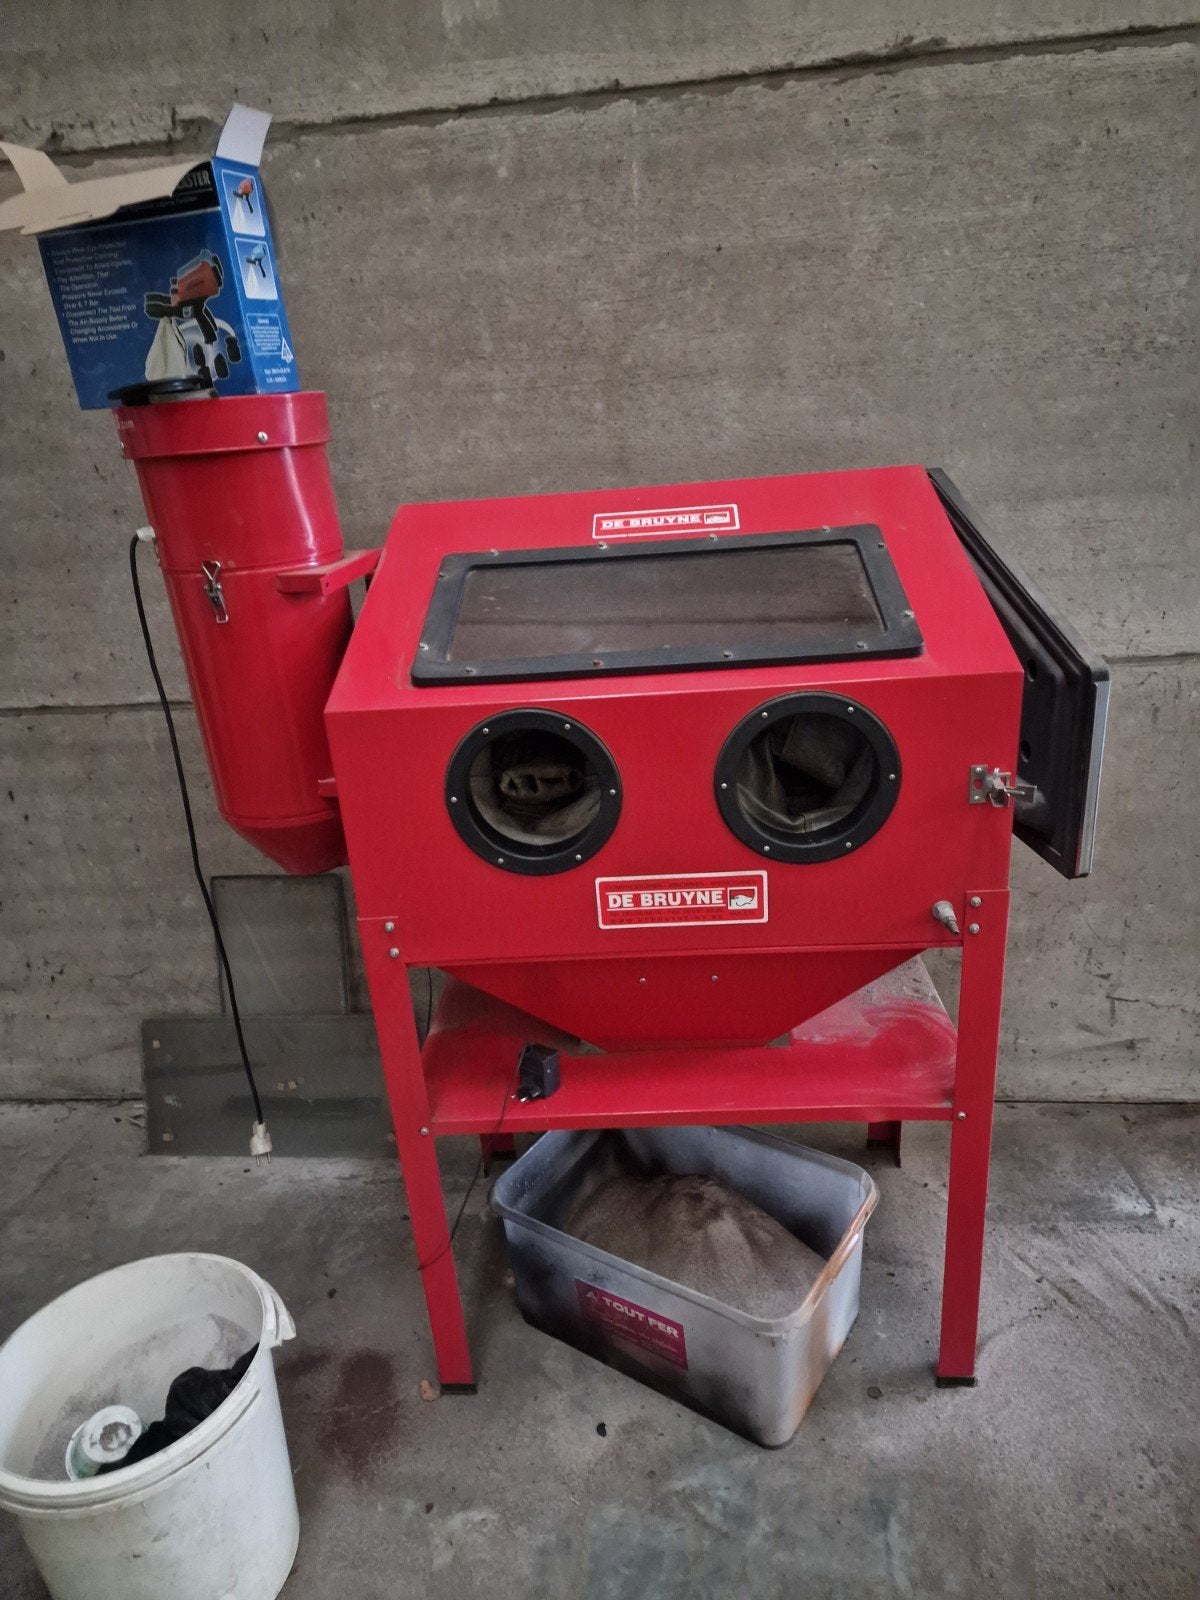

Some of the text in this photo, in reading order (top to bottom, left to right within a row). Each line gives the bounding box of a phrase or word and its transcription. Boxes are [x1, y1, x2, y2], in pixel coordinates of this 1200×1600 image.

[177, 170, 211, 190] ASTER
[601, 514, 703, 530] DE BRUYNE
[608, 890, 724, 909] DE BRUYNE
[602, 1297, 645, 1322] TOUT
[648, 1316, 679, 1339] FER
